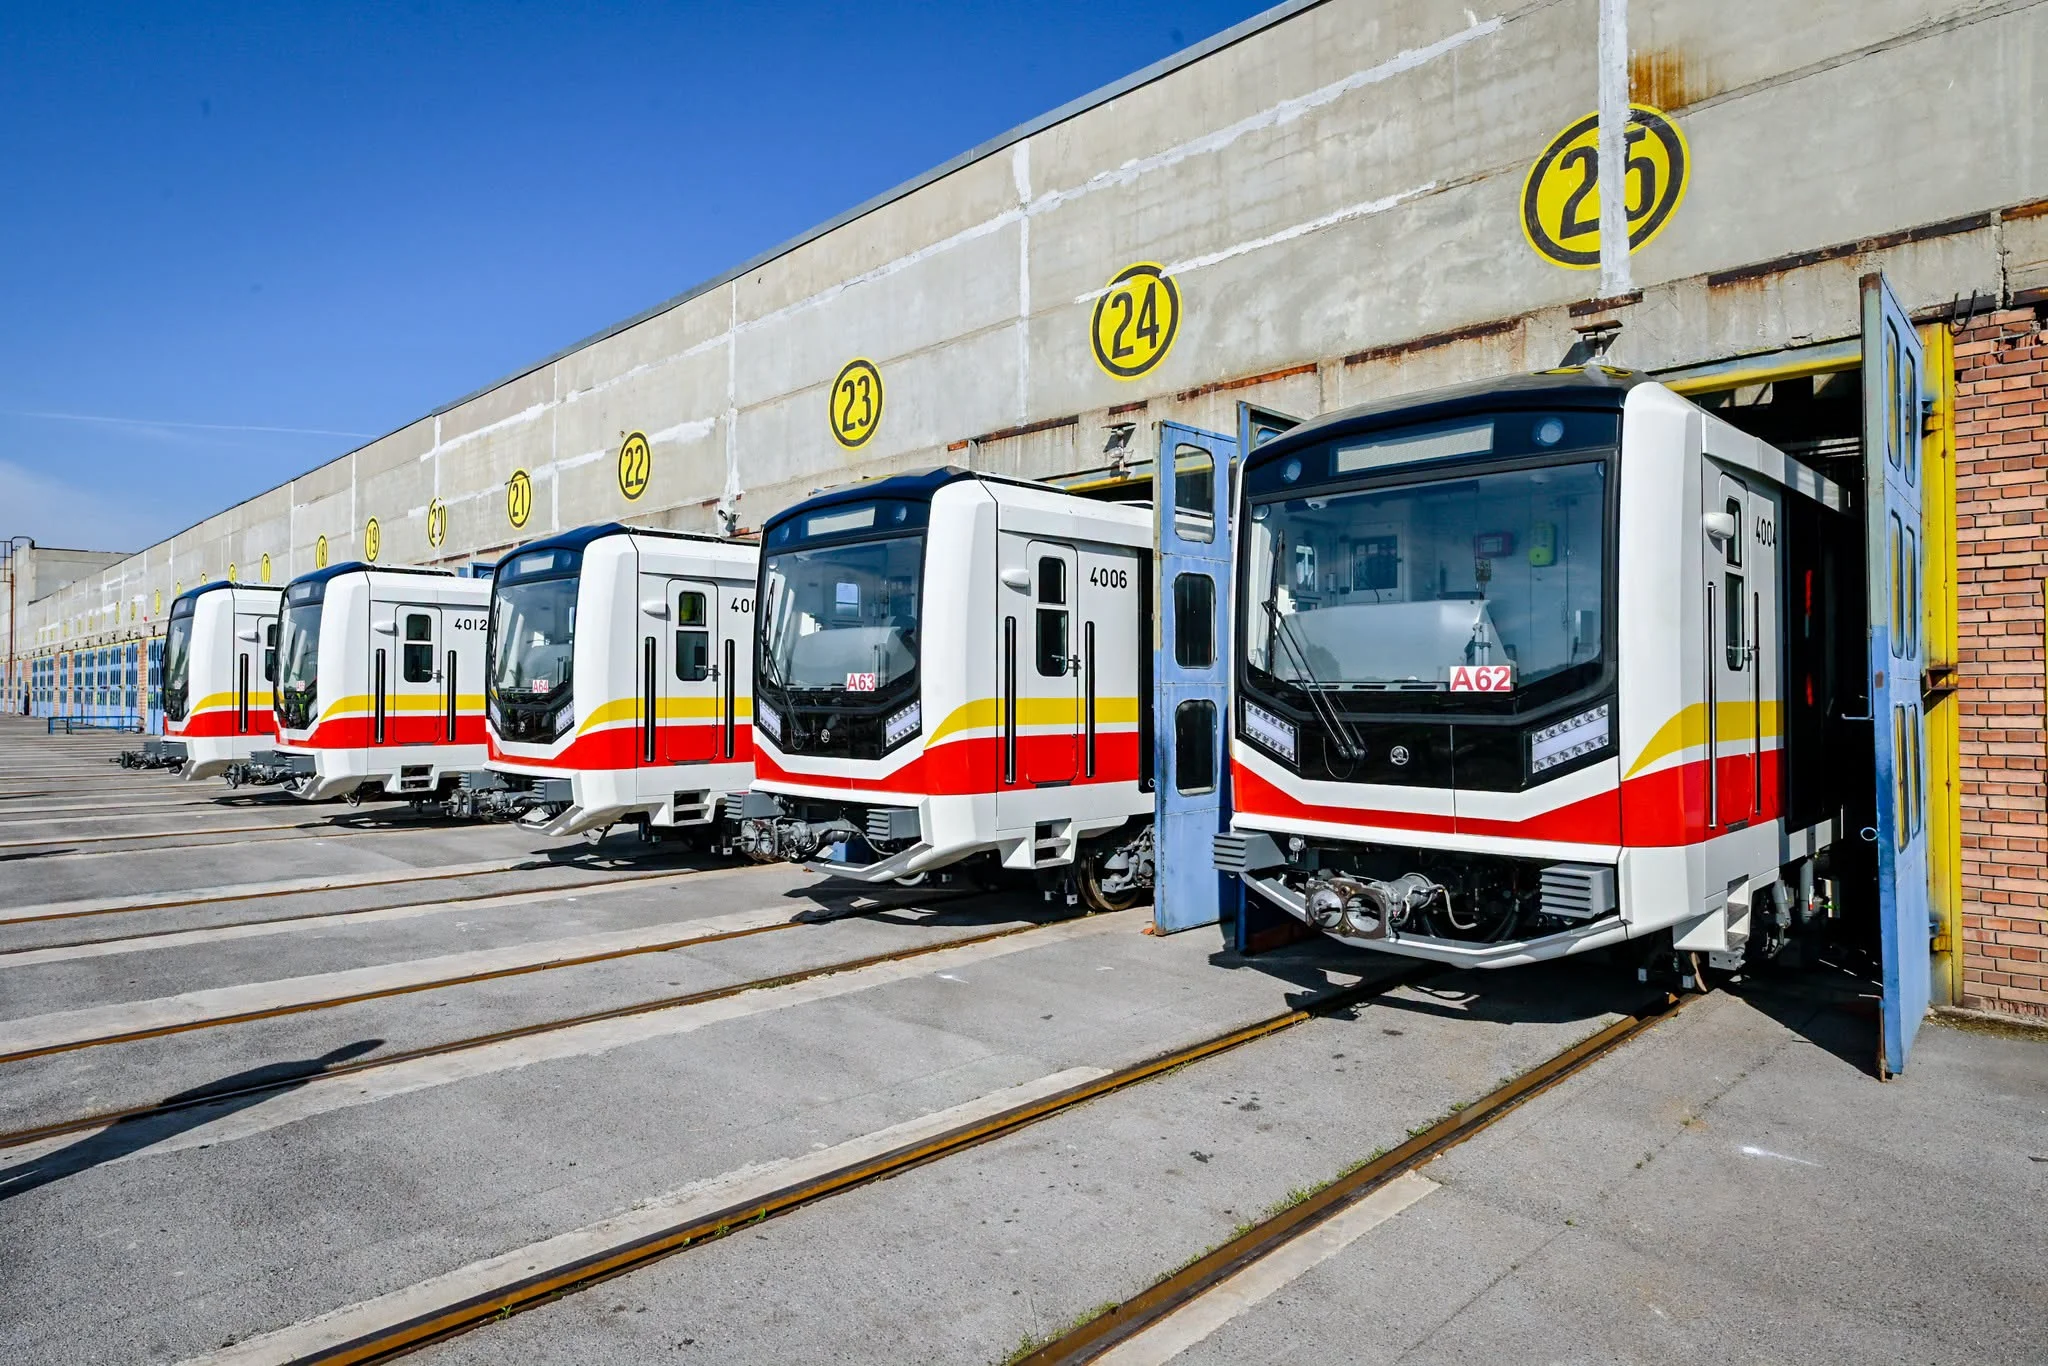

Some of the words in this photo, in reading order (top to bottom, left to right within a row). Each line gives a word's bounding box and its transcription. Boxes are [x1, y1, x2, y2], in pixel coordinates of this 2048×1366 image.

[1558, 126, 1656, 241] 25
[1110, 280, 1160, 360] 24
[841, 374, 872, 433] 23
[624, 444, 645, 489] 22
[511, 480, 525, 518] 21
[368, 525, 377, 556] 19
[1755, 515, 1777, 550] 4004
[1089, 566, 1128, 589] 4006
[454, 617, 488, 631] 4012
[533, 680, 549, 693] A64
[847, 673, 876, 691] A63
[1451, 666, 1511, 691] A62
